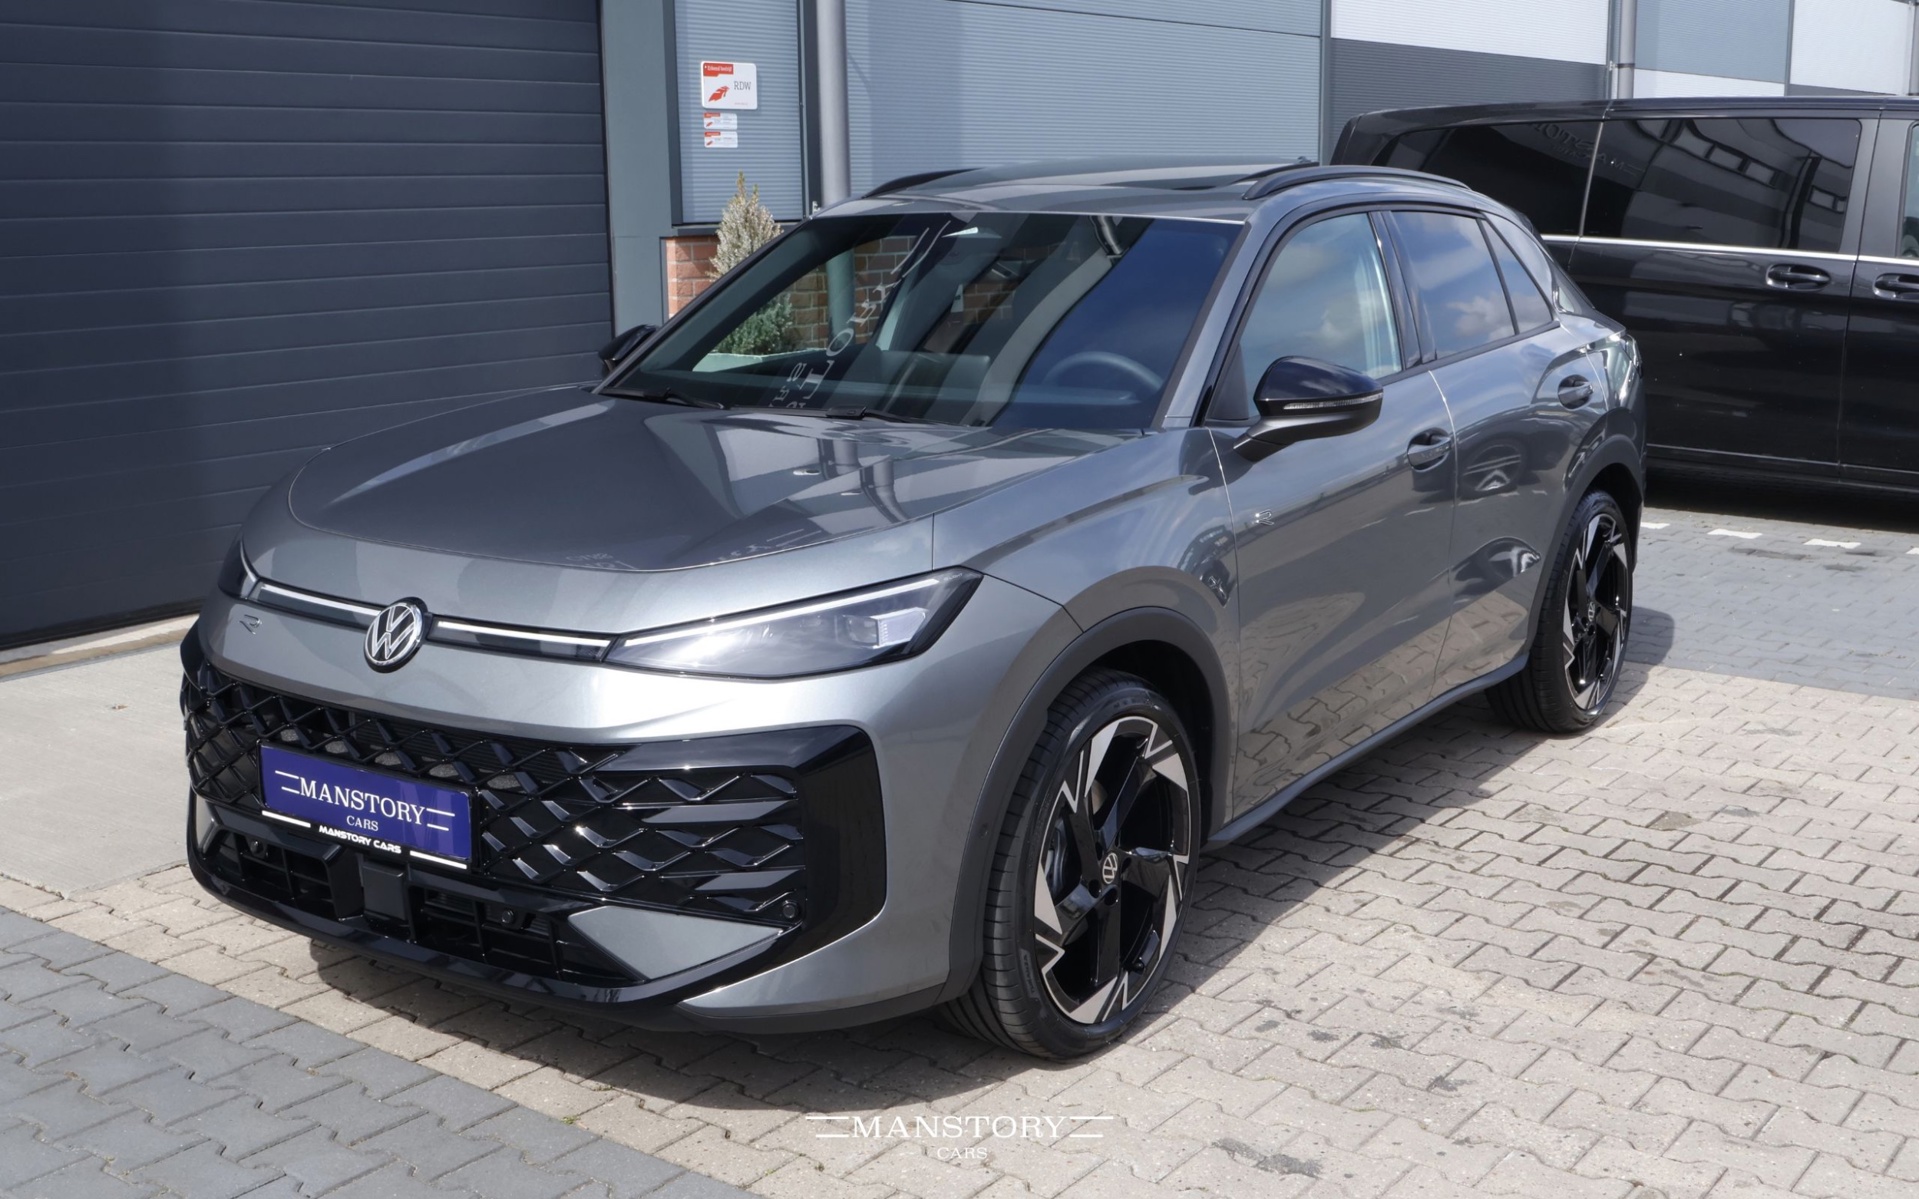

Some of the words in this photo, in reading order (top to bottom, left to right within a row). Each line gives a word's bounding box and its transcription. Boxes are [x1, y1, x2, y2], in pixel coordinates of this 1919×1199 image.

[734, 81, 752, 90] RDW
[298, 776, 427, 825] MANSTORY
[346, 815, 379, 832] CARS
[318, 824, 372, 847] MANSTORY
[373, 838, 402, 855] CARS
